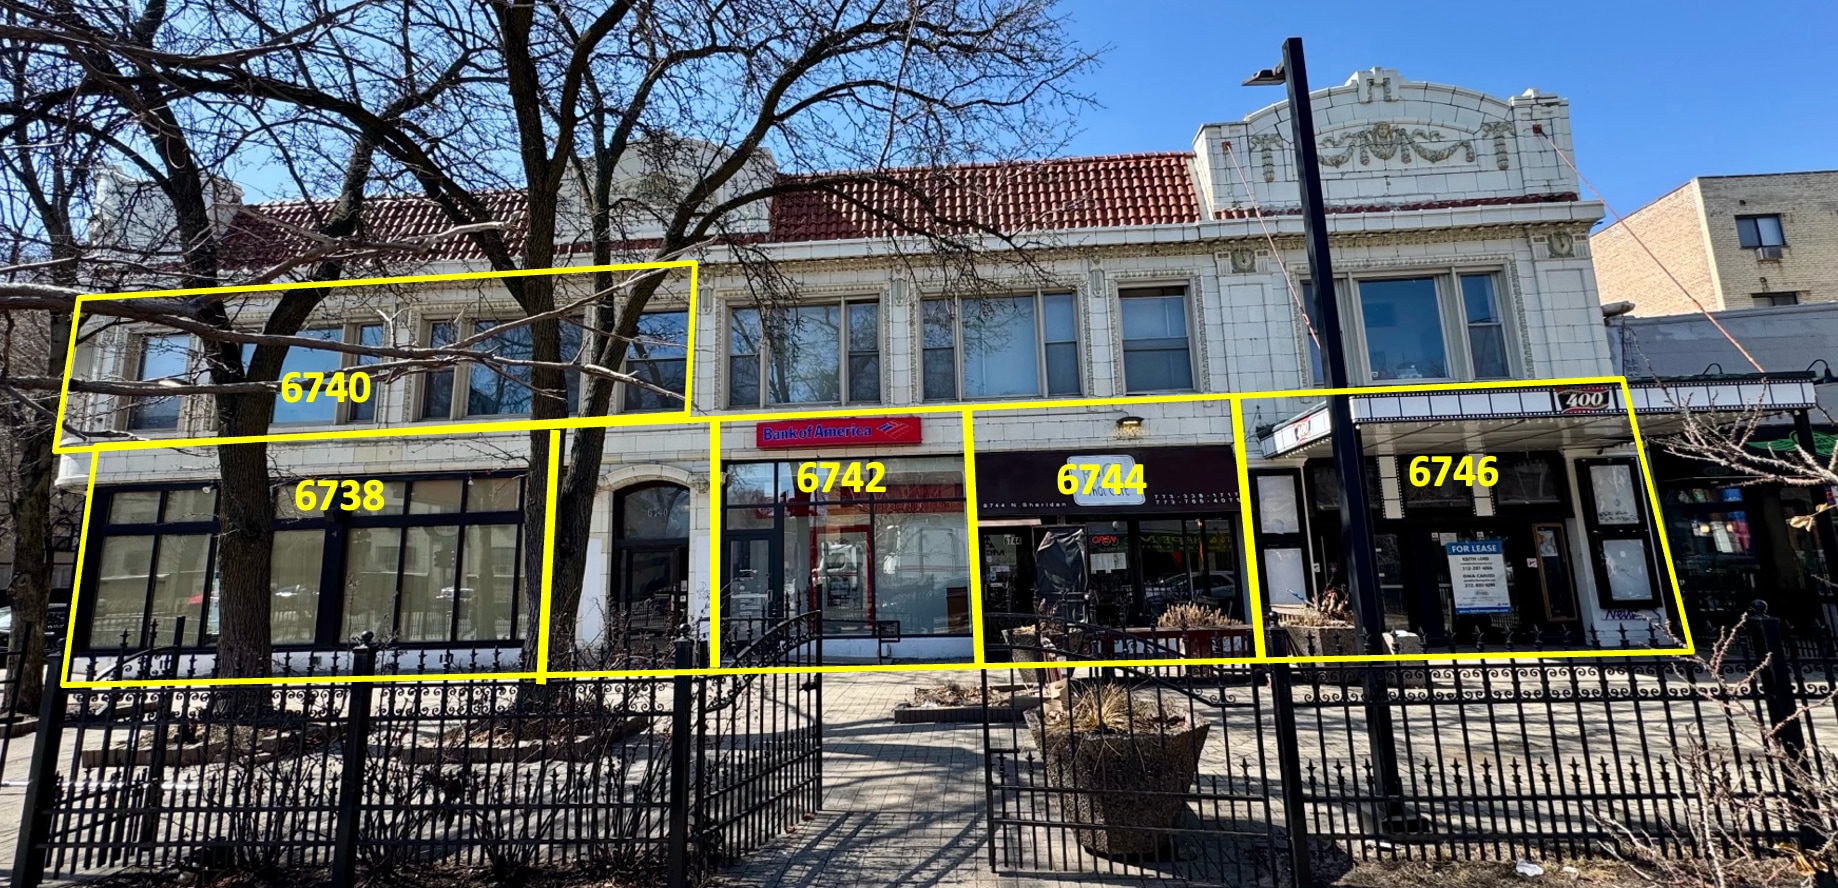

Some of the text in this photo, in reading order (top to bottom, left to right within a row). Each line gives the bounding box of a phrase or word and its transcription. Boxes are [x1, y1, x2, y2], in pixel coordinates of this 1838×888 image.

[1566, 392, 1604, 407] 400
[763, 423, 872, 441] Bank of America
[1091, 535, 1117, 545] OPEN
[1451, 544, 1497, 553] FOR LEASE
